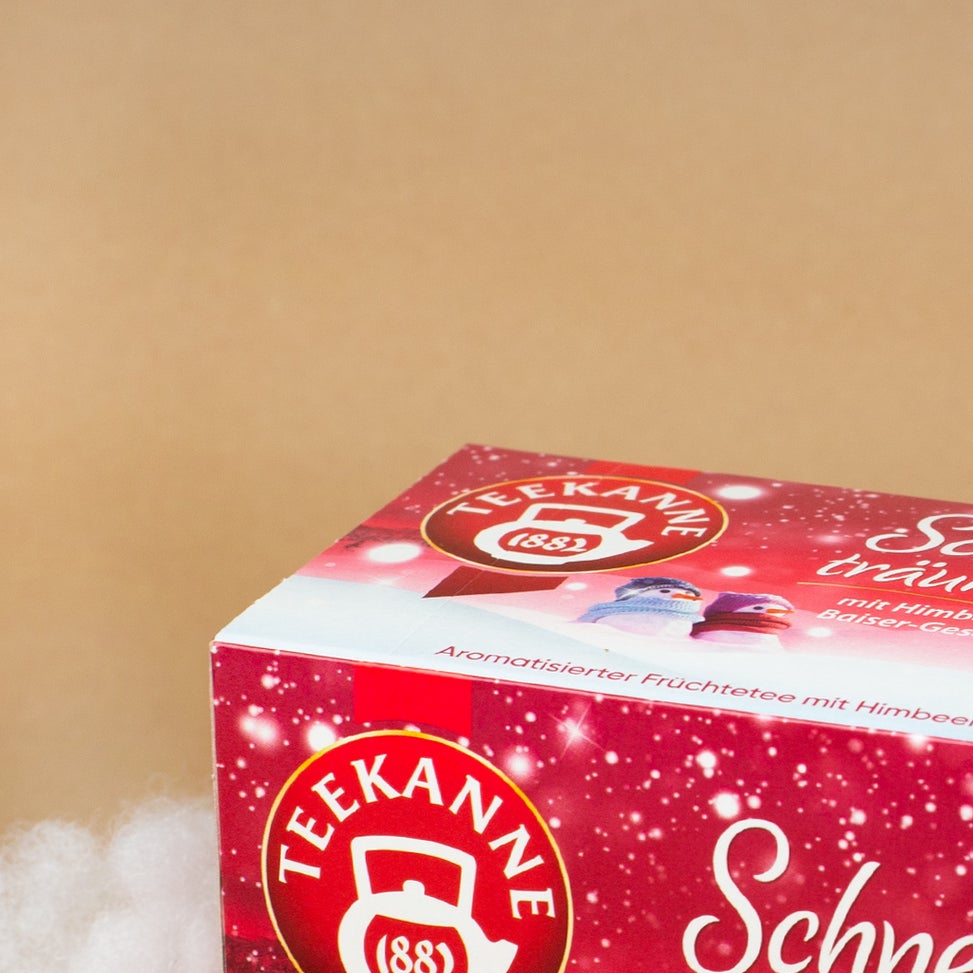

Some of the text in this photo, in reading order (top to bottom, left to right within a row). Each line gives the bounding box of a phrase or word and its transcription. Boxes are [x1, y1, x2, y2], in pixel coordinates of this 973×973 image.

[446, 481, 710, 538] TEEKANNE
[507, 533, 587, 553] 1882
[837, 597, 889, 611] mit
[434, 645, 639, 683] Aromatisierter
[641, 673, 797, 704] Früchtetee
[802, 694, 849, 713] mit
[278, 753, 556, 920] TEEKANNE
